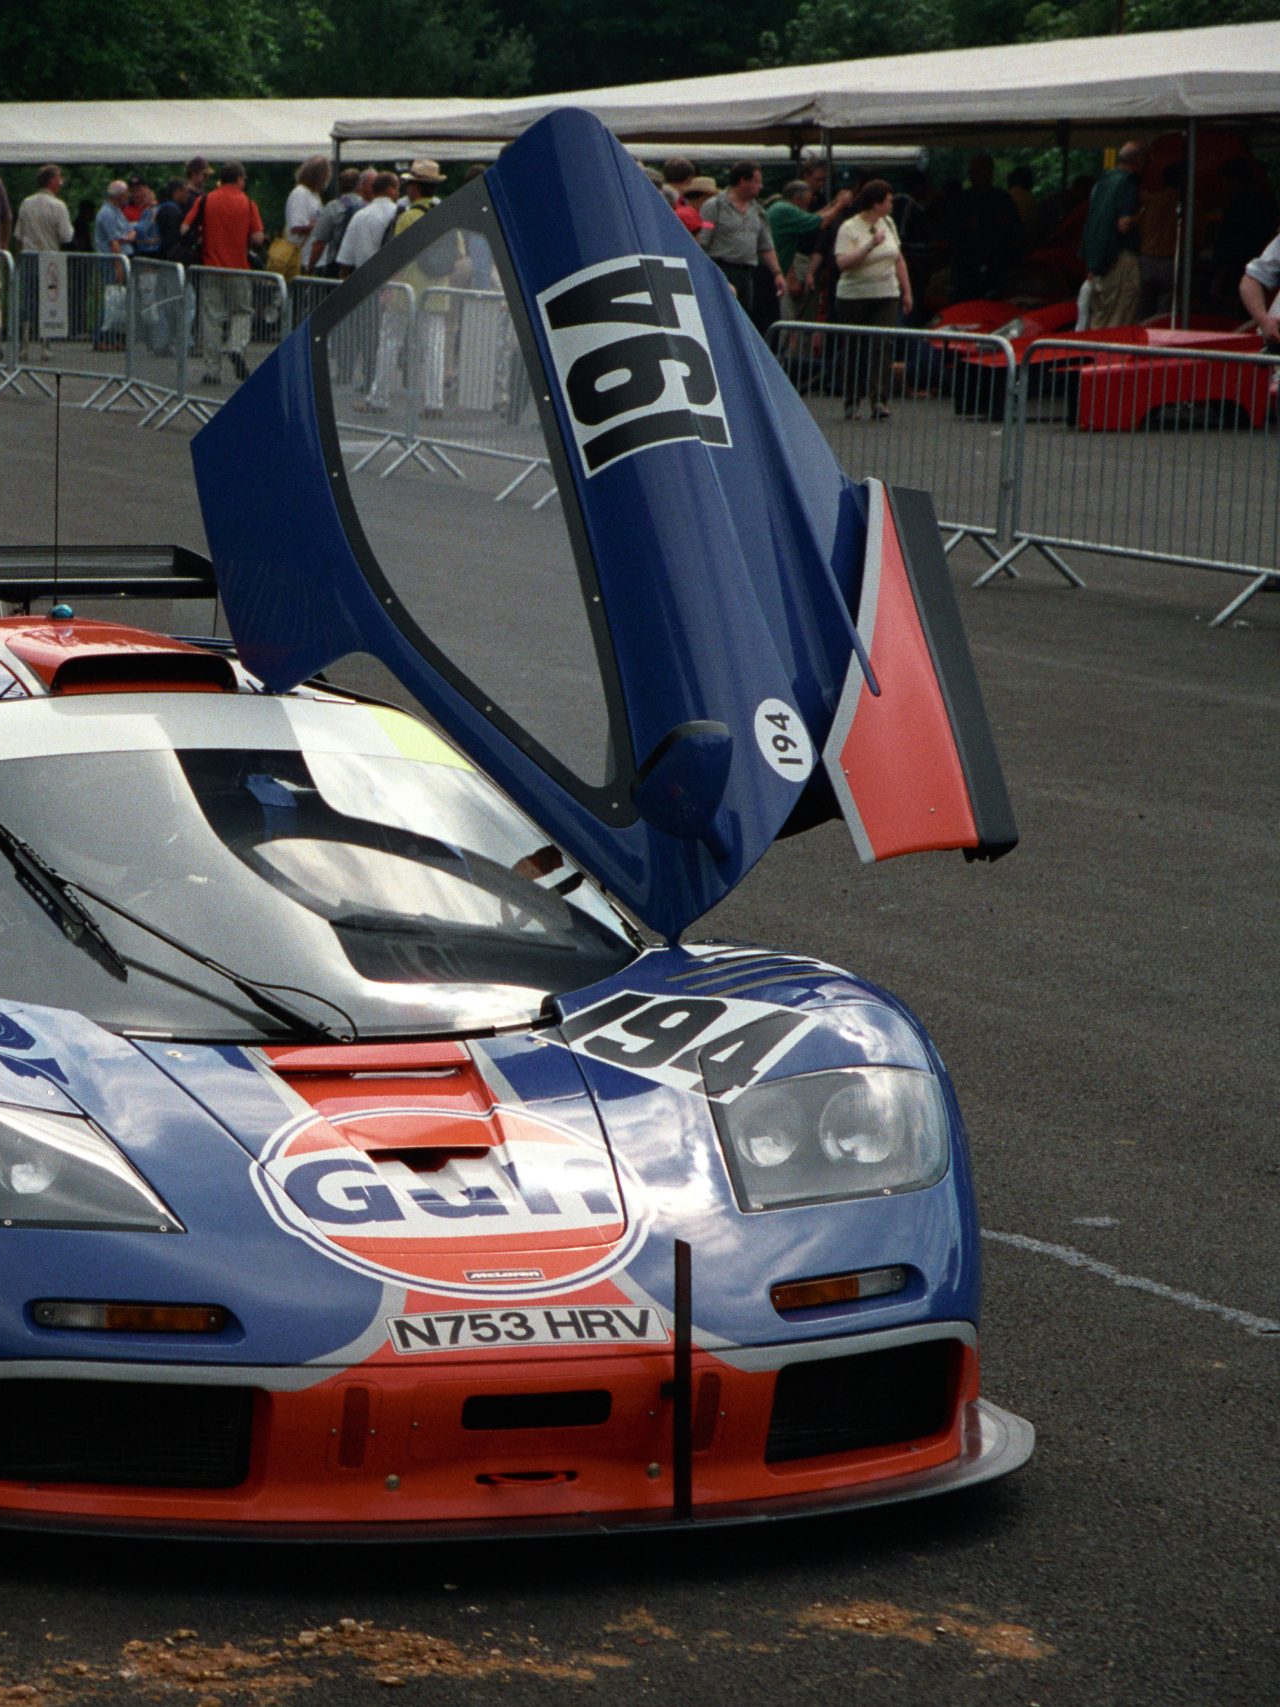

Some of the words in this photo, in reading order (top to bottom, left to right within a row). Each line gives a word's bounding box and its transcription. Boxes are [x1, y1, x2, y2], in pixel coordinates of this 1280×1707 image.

[545, 258, 729, 472] 194
[764, 712, 803, 765] 194
[538, 994, 810, 1100] 194
[393, 1312, 536, 1349] N753
[543, 1309, 650, 1339] HRV
